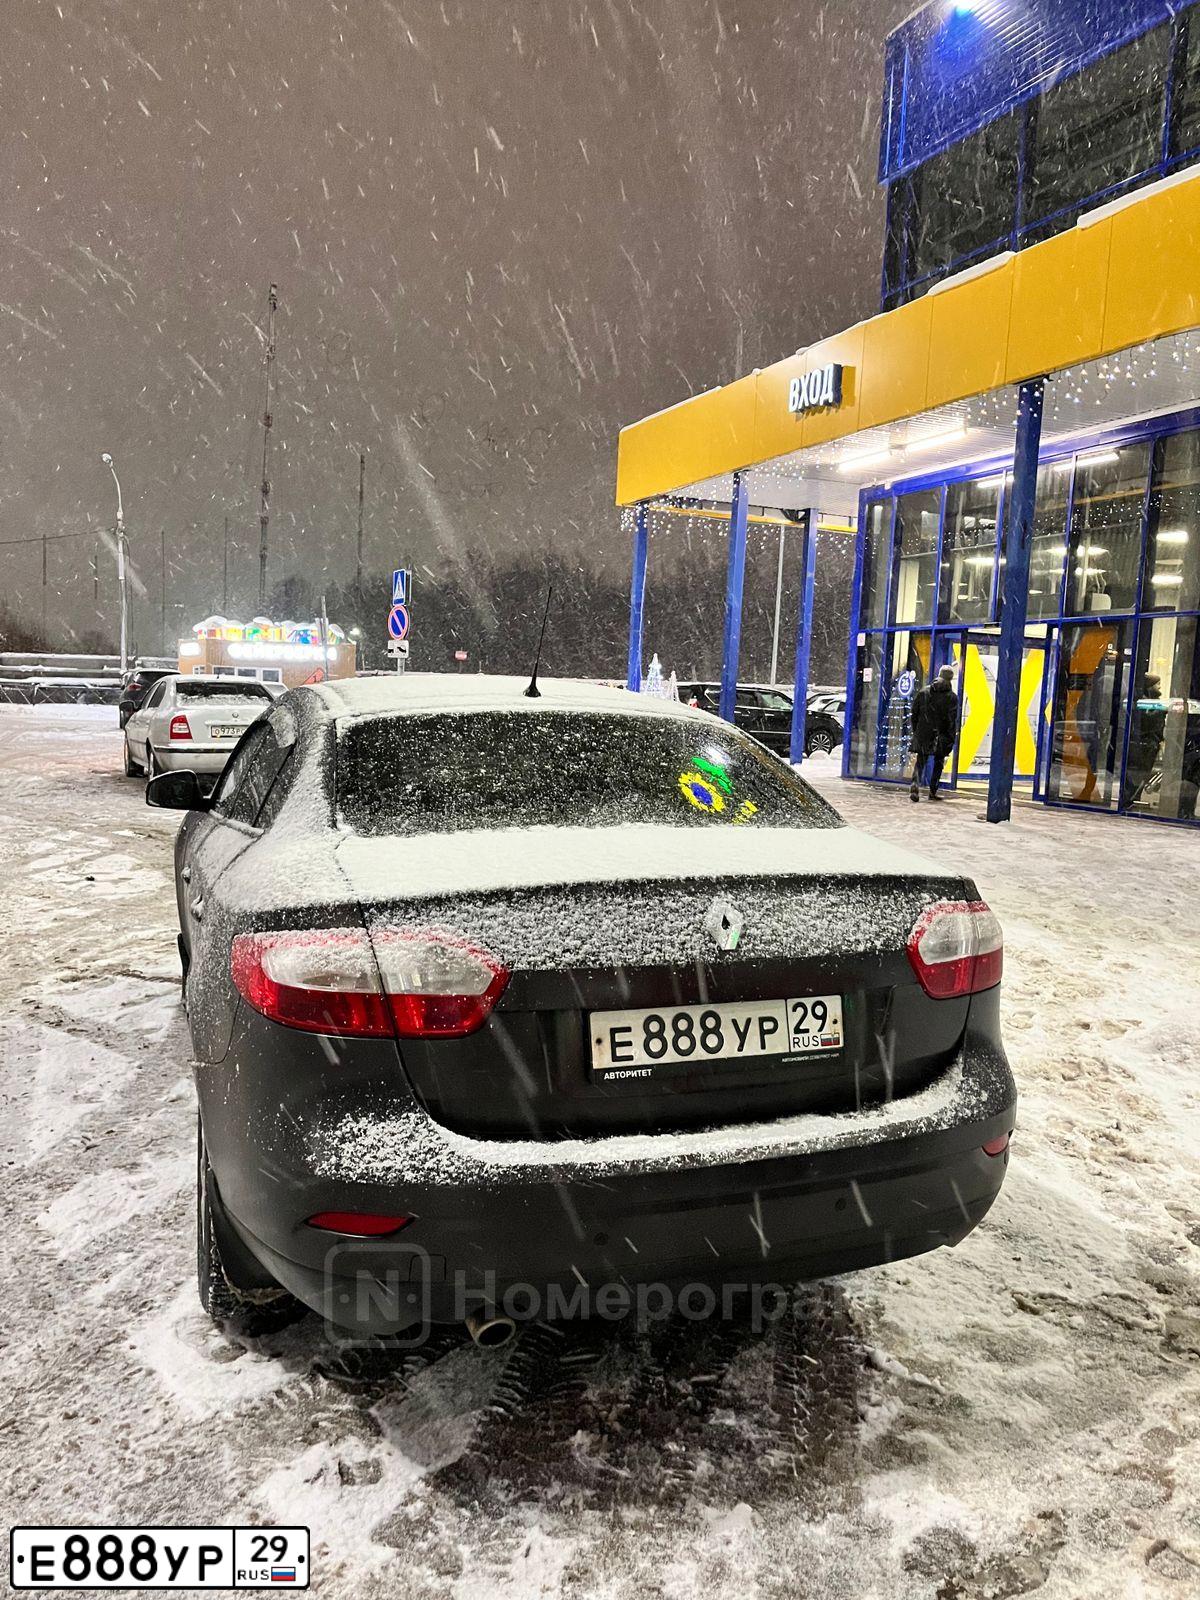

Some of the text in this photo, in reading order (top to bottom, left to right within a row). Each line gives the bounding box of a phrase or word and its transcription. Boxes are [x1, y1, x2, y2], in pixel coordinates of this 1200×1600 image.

[788, 362, 835, 413] ВХОД
[609, 1000, 828, 1062] Е888УР 29
[793, 1035, 820, 1049] RUS
[604, 1069, 653, 1080] АВТОРИТЕТ
